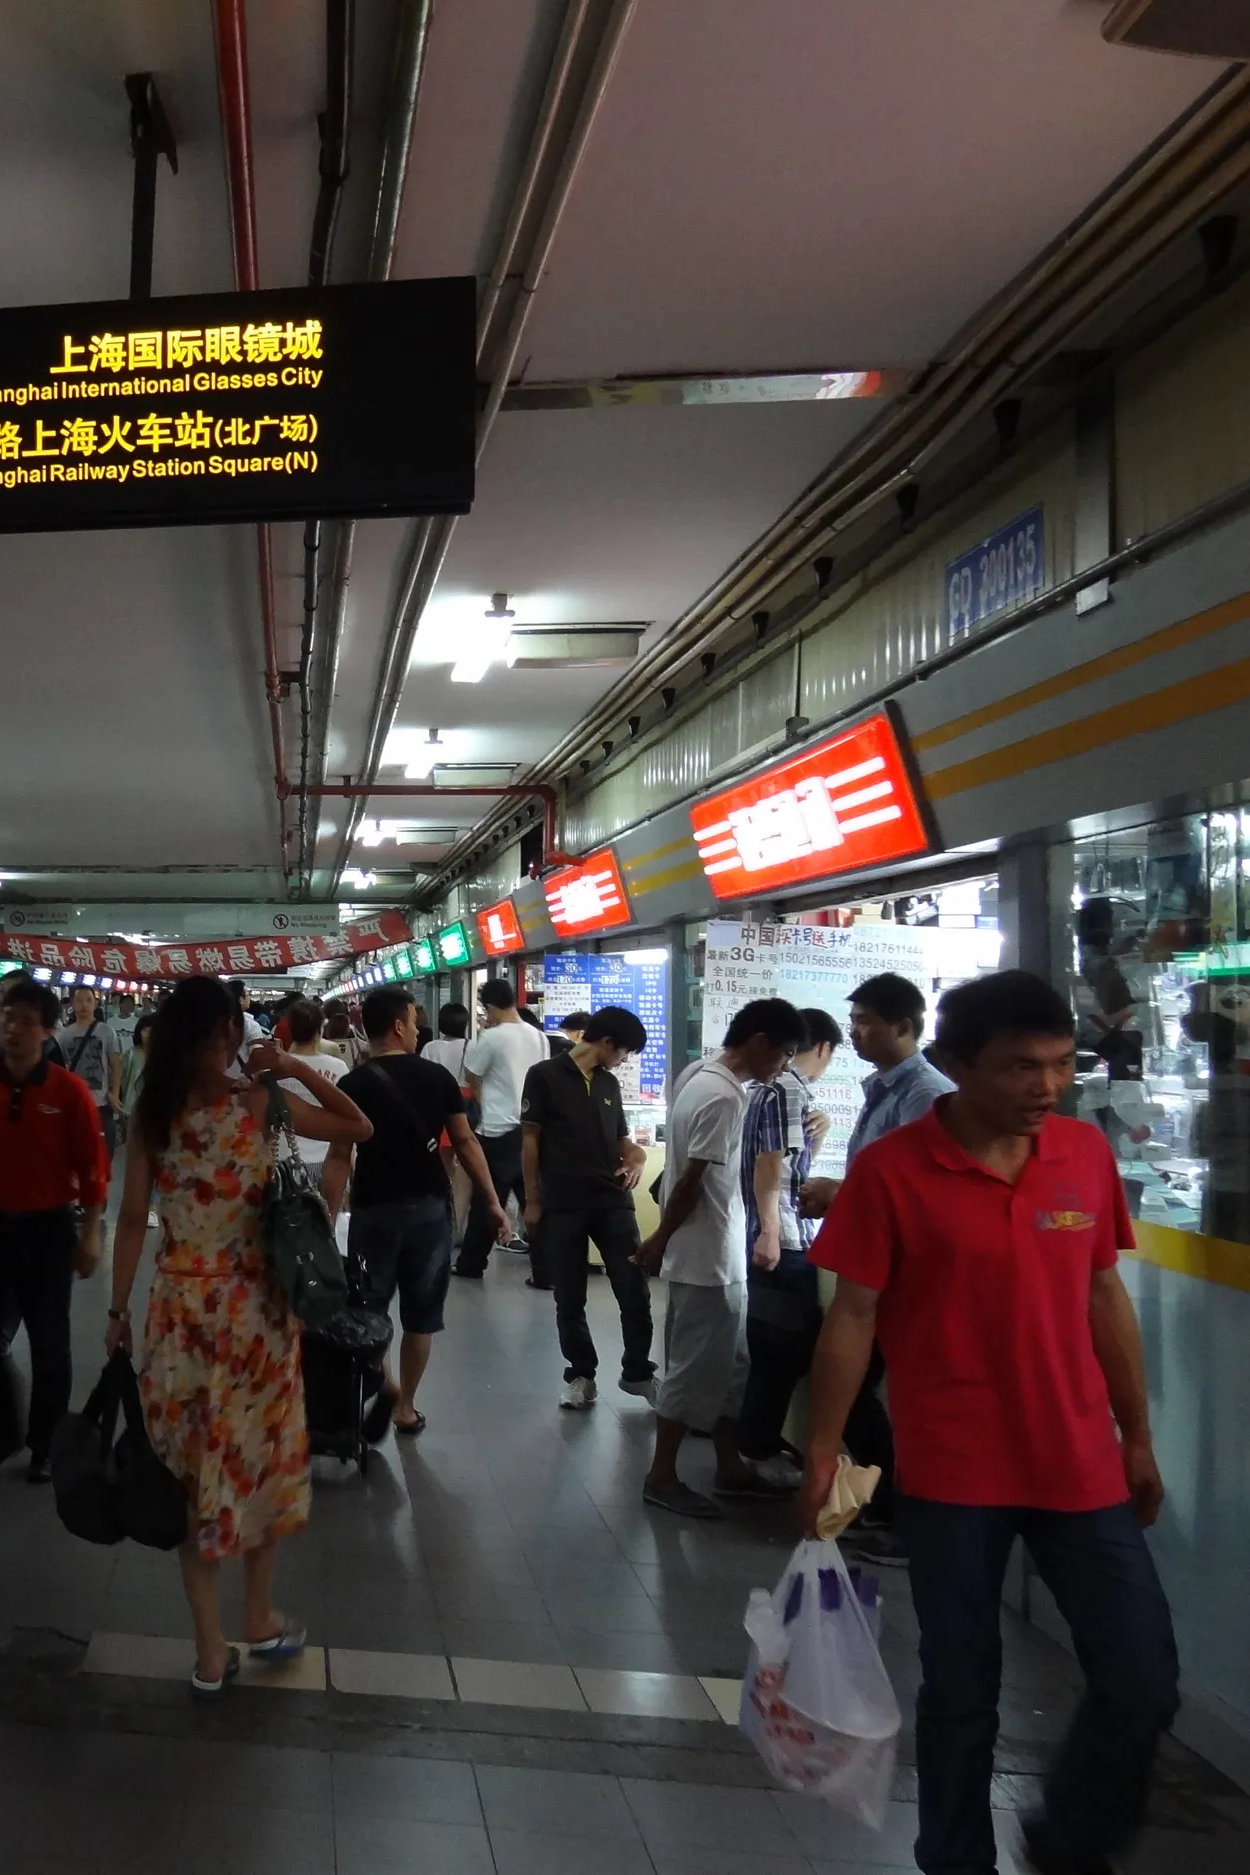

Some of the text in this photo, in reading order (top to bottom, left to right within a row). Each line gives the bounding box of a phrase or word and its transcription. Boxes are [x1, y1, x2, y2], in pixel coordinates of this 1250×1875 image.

[50, 320, 323, 373] 上海国际眼镜城
[62, 374, 190, 398] International
[193, 372, 278, 391] Glasses
[281, 367, 323, 388] City
[50, 463, 130, 482] Railway
[132, 458, 205, 477] Station
